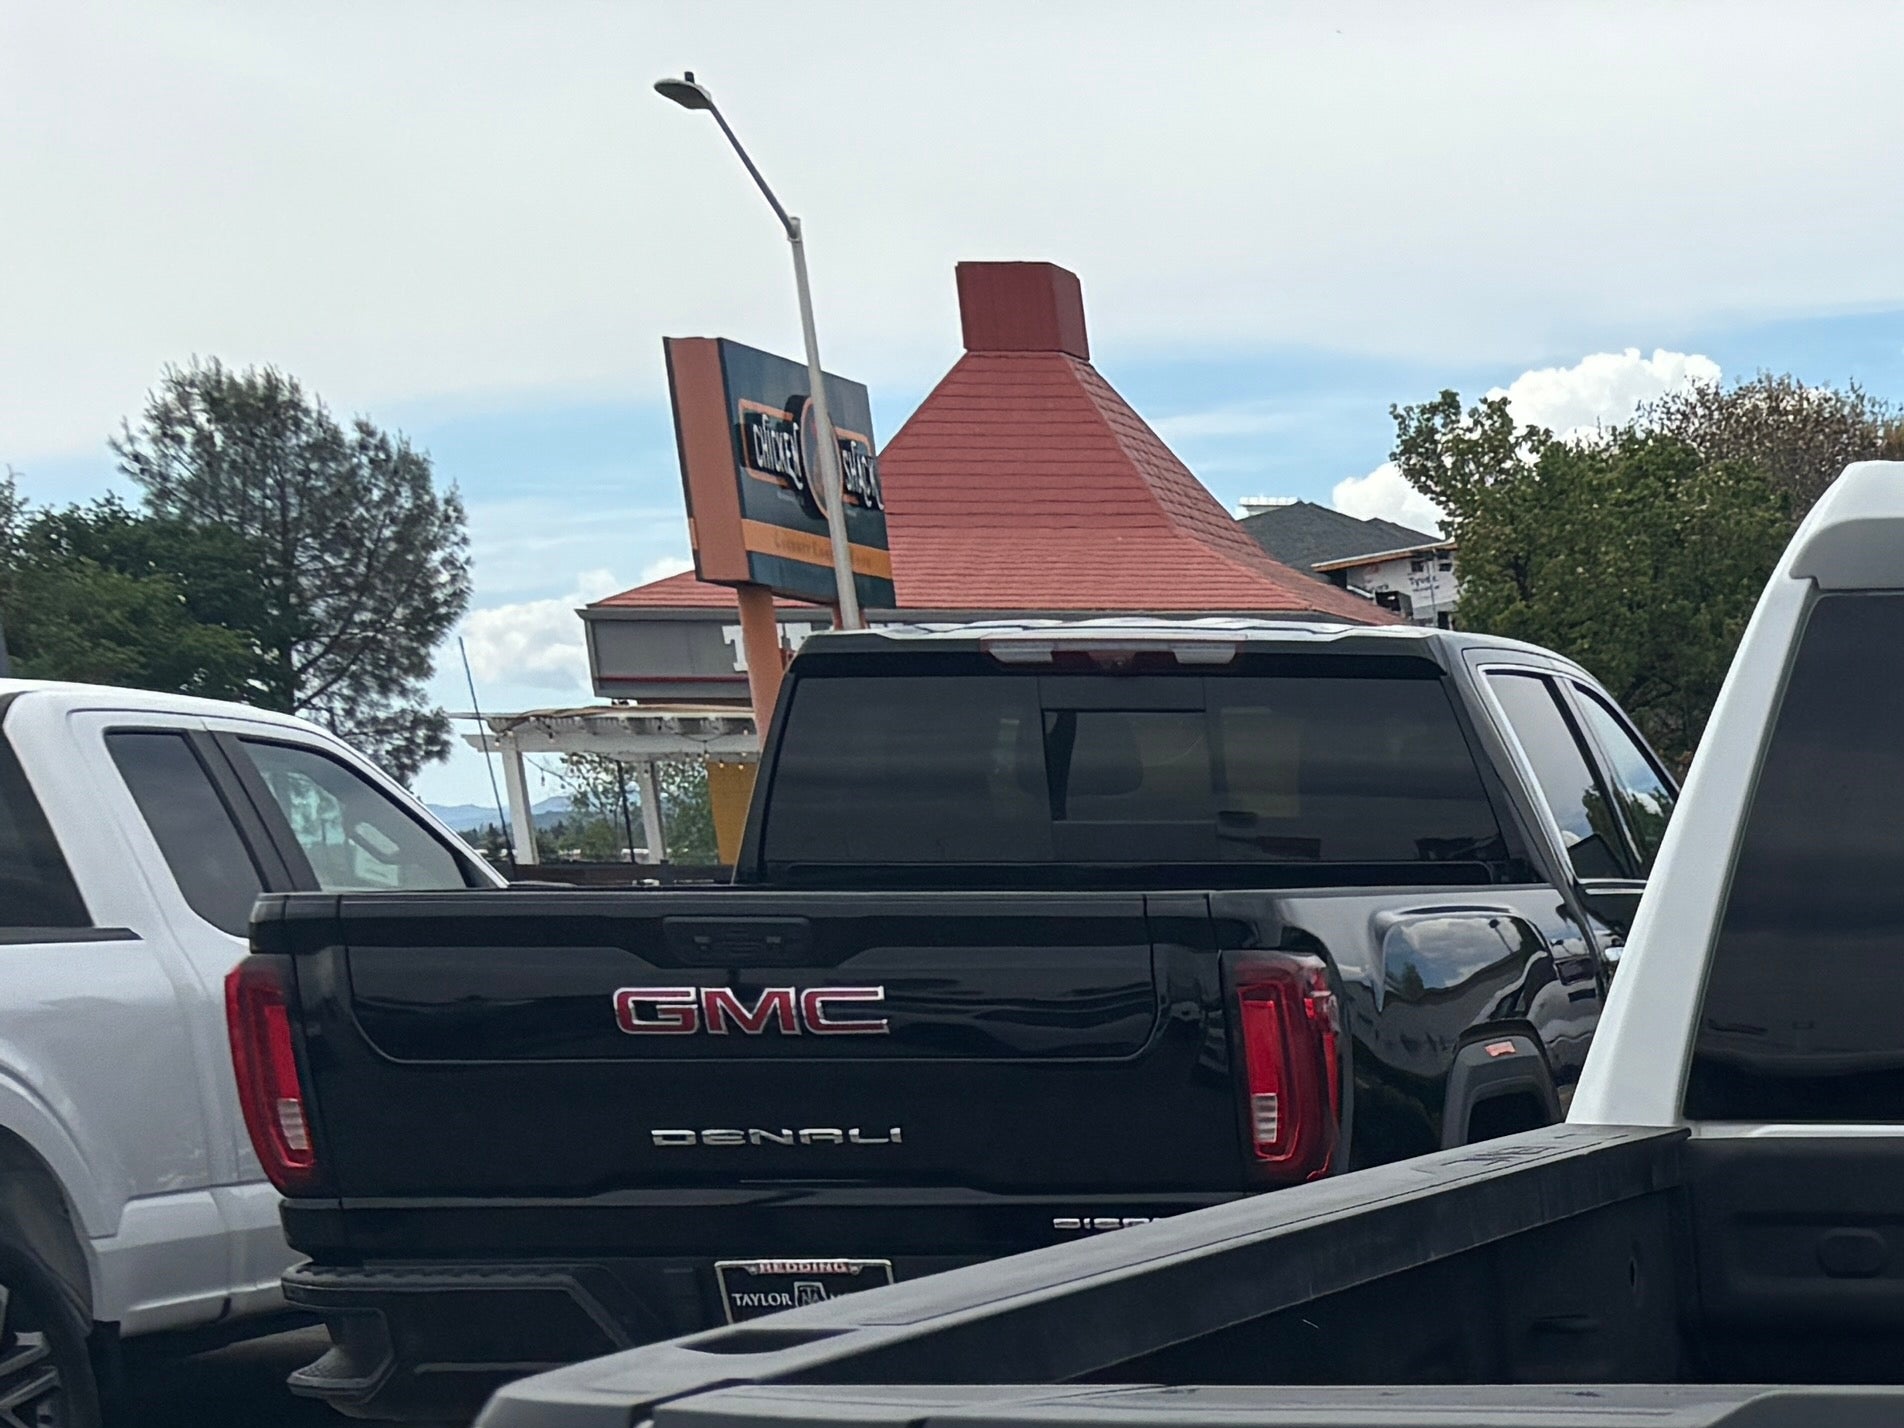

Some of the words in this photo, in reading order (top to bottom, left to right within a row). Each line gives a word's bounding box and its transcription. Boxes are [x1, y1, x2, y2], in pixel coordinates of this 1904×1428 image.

[753, 414, 803, 490] CHICKEN
[612, 985, 890, 1036] GMC
[651, 1127, 902, 1147] DENALI
[758, 1262, 848, 1274] REDDING
[731, 1292, 793, 1307] TAYLOR
